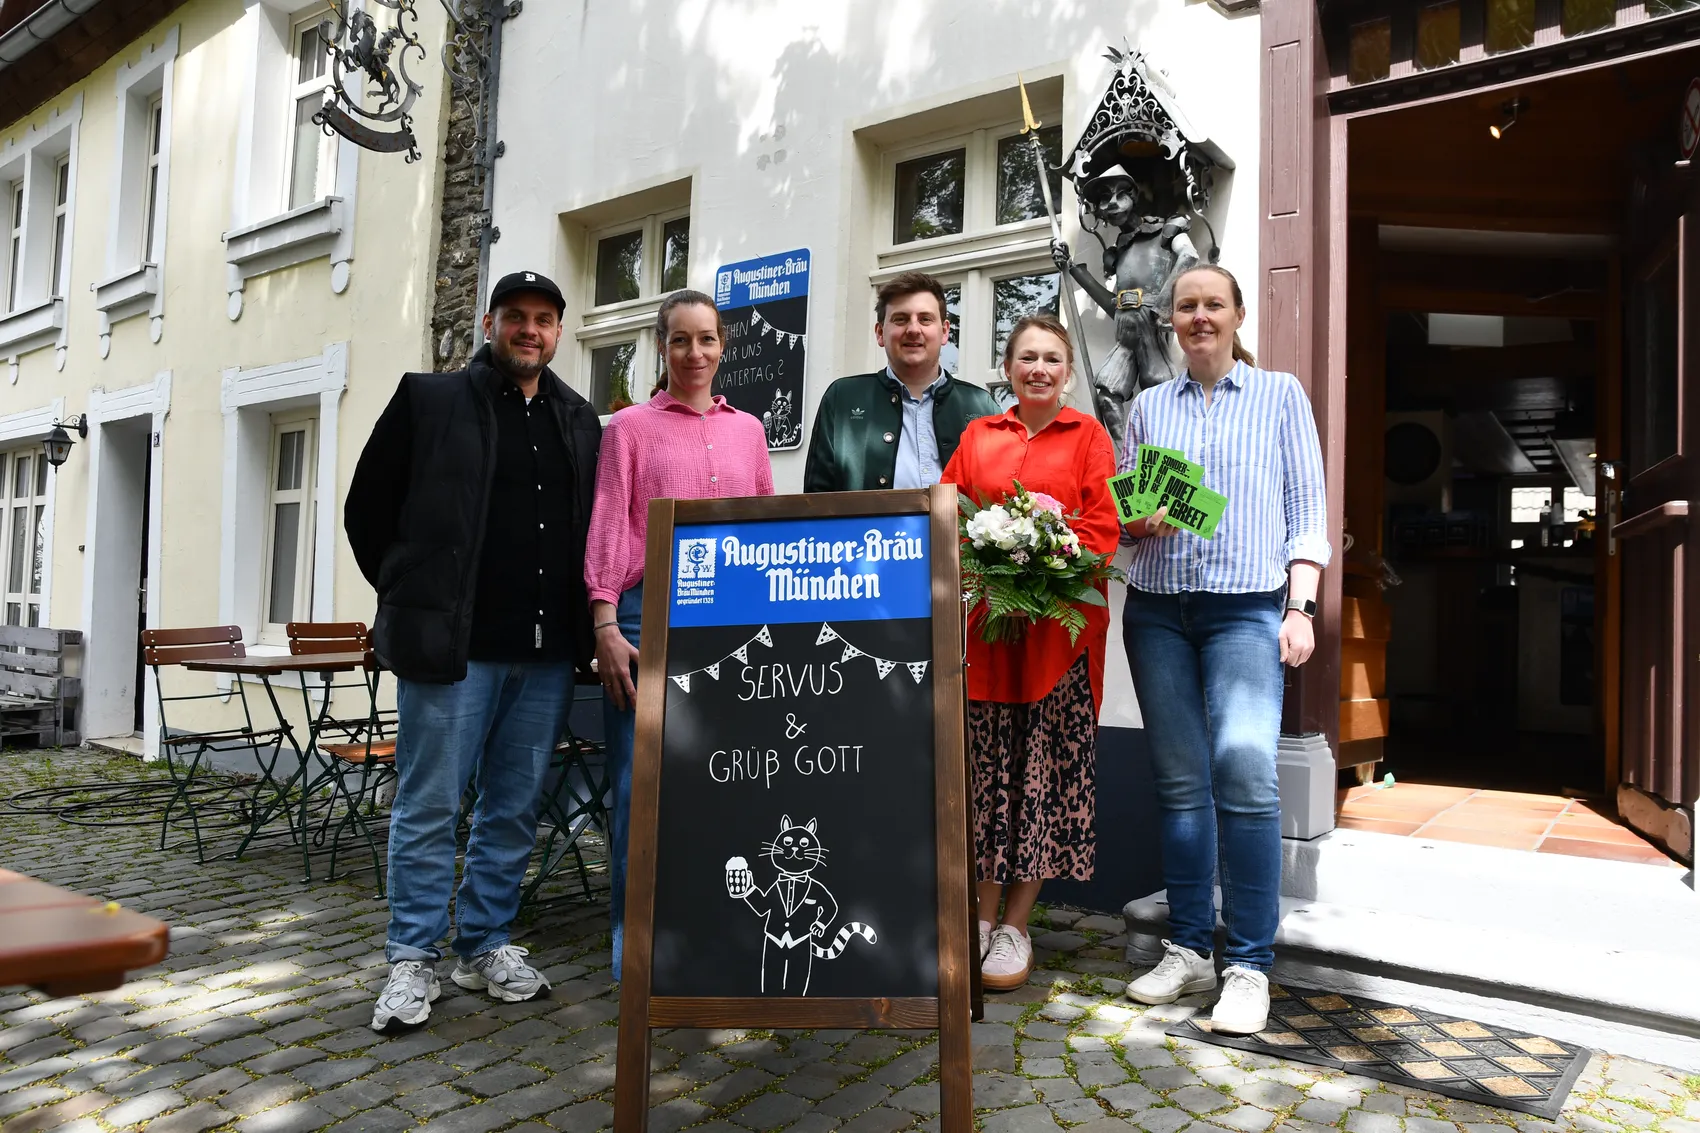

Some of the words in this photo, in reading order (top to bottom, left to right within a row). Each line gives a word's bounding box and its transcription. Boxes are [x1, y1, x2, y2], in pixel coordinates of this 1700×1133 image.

[748, 280, 790, 301] München
[741, 341, 762, 359] UNS
[719, 364, 774, 389] VATERTAG
[1168, 501, 1208, 531] GREET
[765, 566, 880, 602] München
[737, 662, 843, 701] SERVUS
[785, 713, 807, 739] &
[794, 745, 863, 776] GOTT
